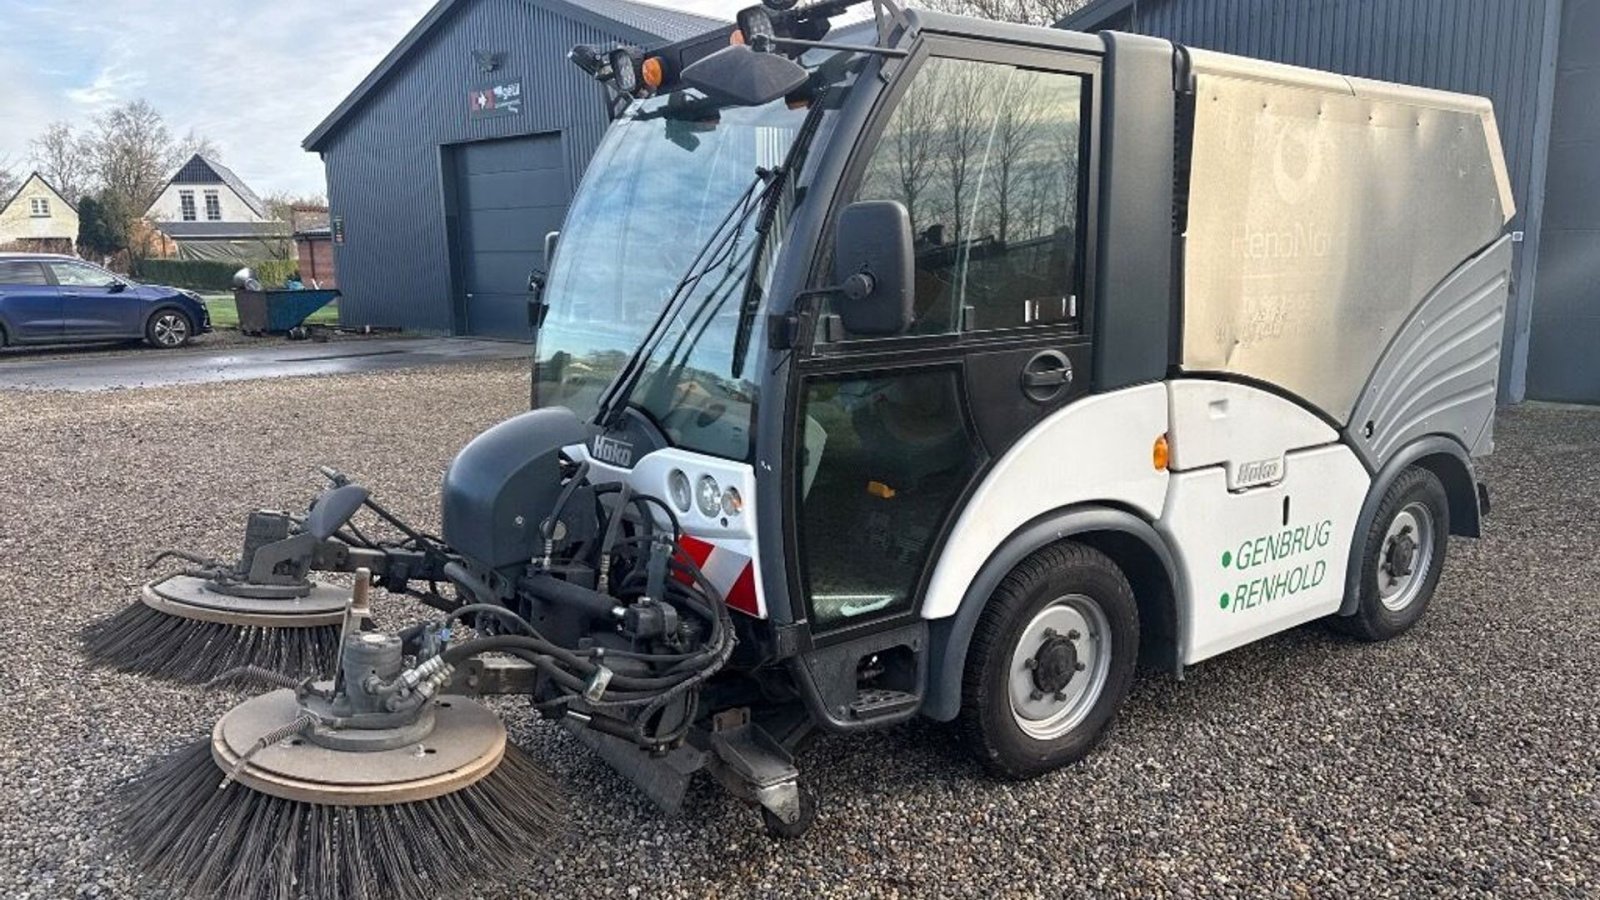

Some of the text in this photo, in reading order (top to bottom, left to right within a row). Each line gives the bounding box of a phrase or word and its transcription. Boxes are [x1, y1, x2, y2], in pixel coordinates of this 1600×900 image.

[593, 435, 633, 466] Hako
[1236, 519, 1332, 570] GENBRUG
[1232, 560, 1326, 613] RENHOLD
